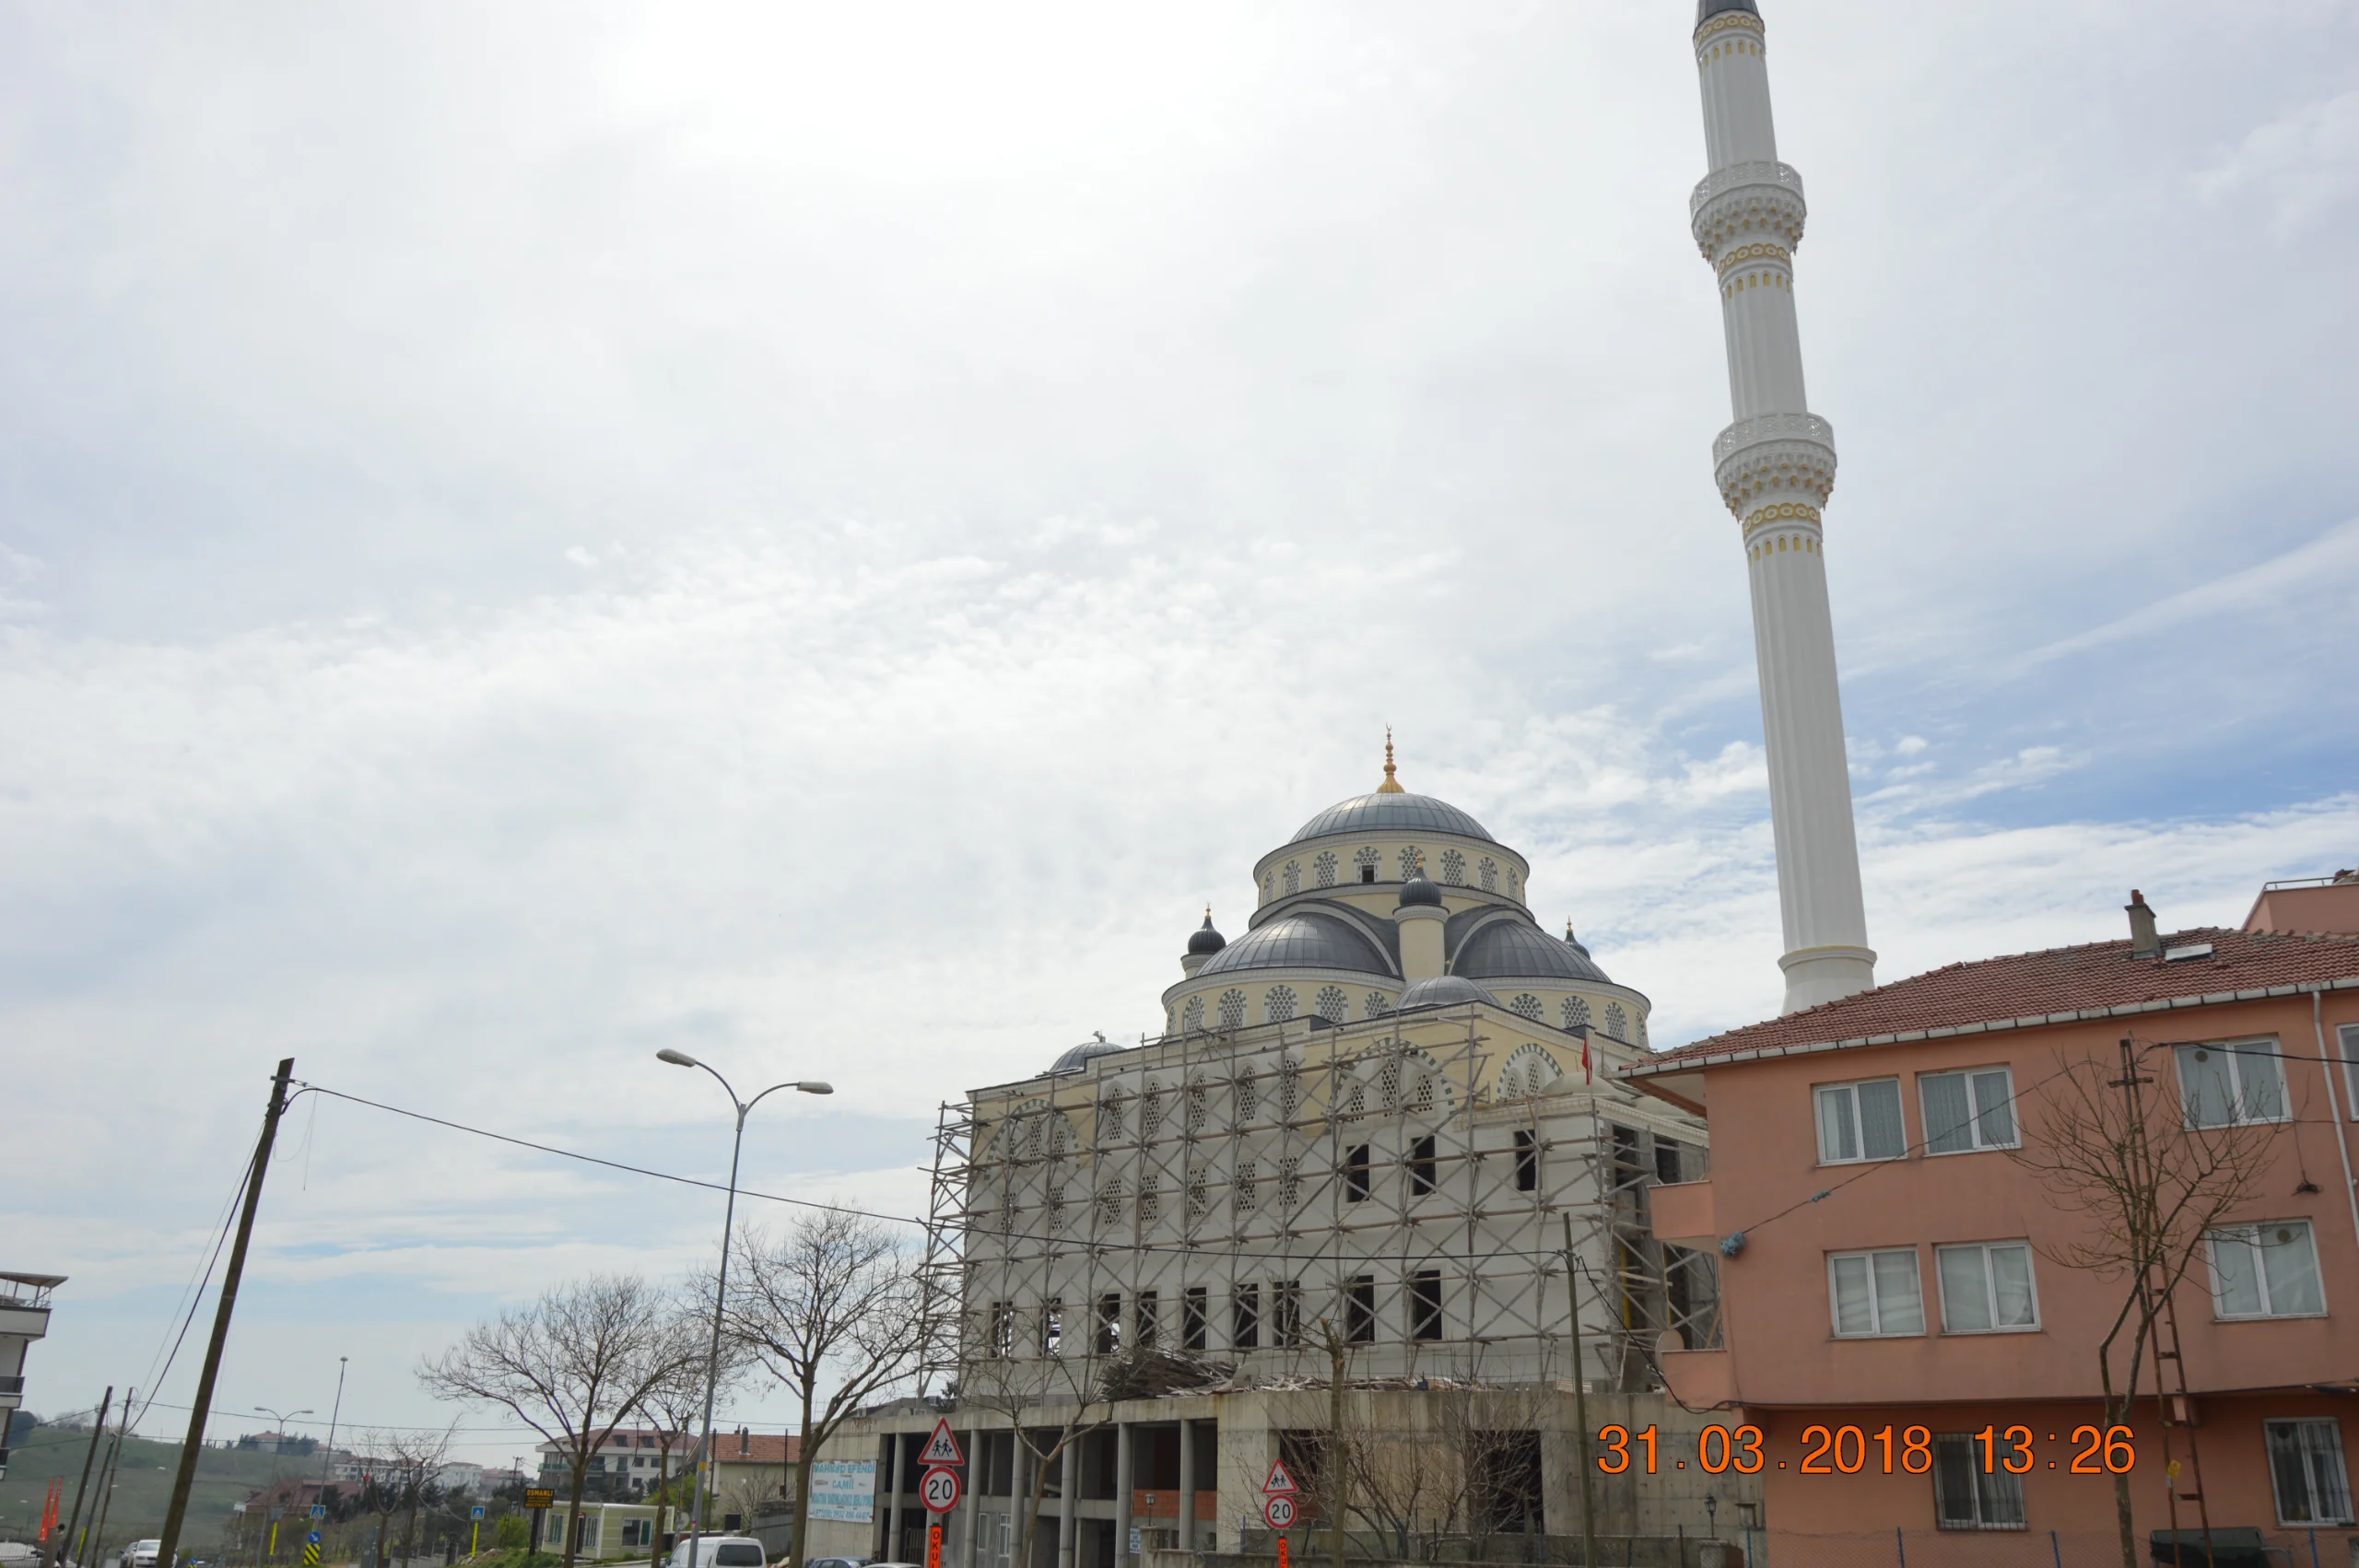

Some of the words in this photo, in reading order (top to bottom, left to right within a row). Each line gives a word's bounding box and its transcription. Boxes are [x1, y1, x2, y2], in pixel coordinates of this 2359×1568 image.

[848, 1462, 874, 1473] EFENDİ
[929, 1480, 953, 1500] 20
[1272, 1504, 1291, 1519] 20
